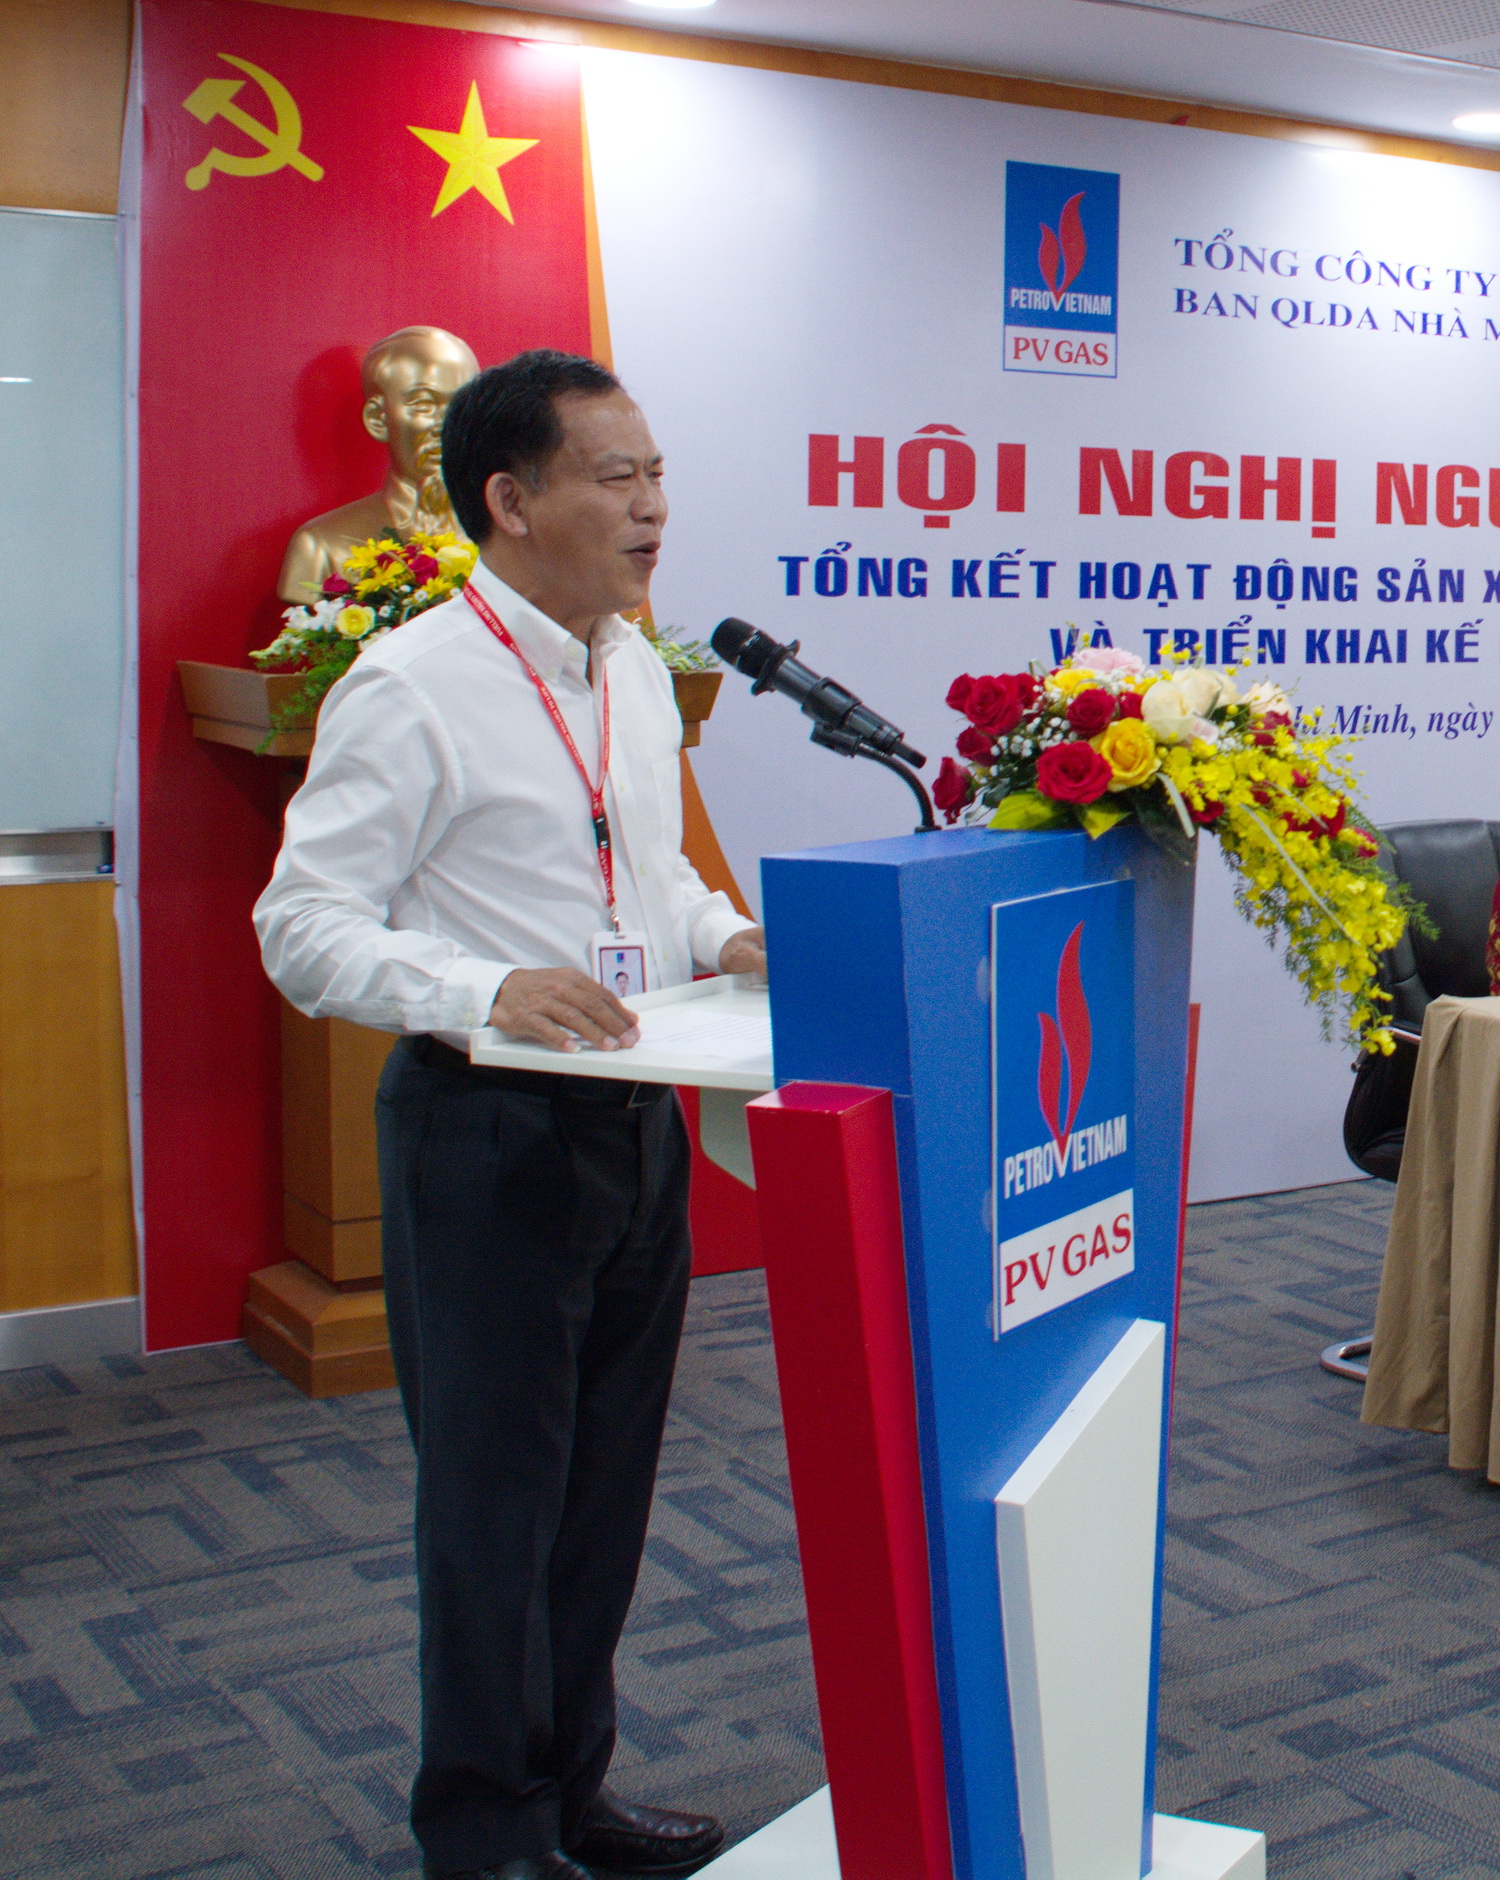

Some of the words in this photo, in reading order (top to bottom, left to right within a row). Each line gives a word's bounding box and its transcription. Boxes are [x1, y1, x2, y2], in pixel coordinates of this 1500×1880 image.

[1175, 229, 1299, 277] TỔNG
[1315, 250, 1431, 291] CÔNG
[1446, 268, 1496, 297] TY
[1010, 287, 1112, 316] PETROVIETNAM
[1175, 288, 1258, 319] BAN
[1271, 298, 1379, 330] QLDA
[1393, 308, 1470, 339] NHÀ
[1013, 337, 1049, 362] PV
[1054, 340, 1109, 366] GAS
[808, 423, 1026, 528] HỘI
[1079, 447, 1337, 538] NGHỊ
[778, 541, 927, 597] TỔNG
[952, 548, 1056, 599] KẾT
[1079, 561, 1211, 607] HOẠT
[1233, 558, 1357, 609] ĐỘNG
[1377, 559, 1464, 603] SẢN
[1143, 615, 1286, 665] TRIỂN
[1305, 628, 1407, 664] KHAI
[1425, 619, 1482, 664] KẾ
[1331, 703, 1416, 741] Minh,
[1427, 701, 1493, 740] ngày
[1004, 1113, 1128, 1199] PETROVIETNAM
[1003, 1245, 1057, 1306] PV
[1062, 1212, 1132, 1278] GAS
